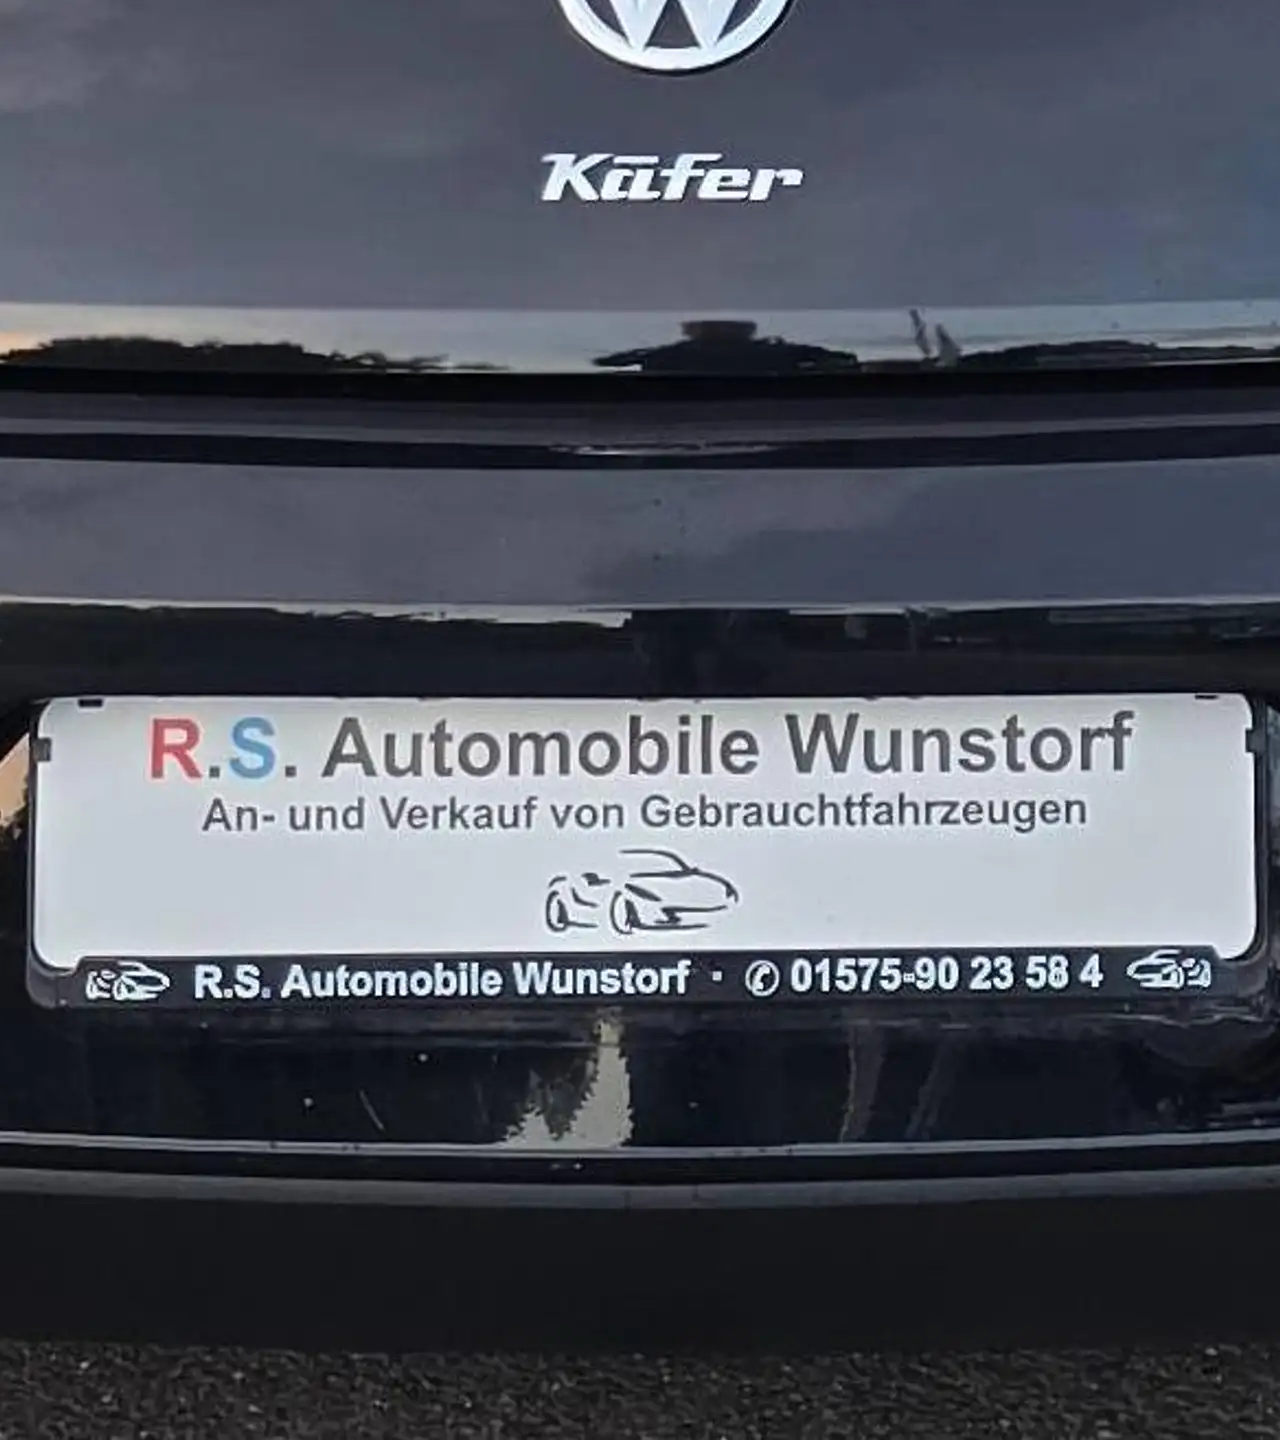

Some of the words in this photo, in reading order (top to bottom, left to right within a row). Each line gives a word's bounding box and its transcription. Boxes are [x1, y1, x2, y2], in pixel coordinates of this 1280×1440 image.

[149, 715, 297, 780] R.S.
[320, 714, 759, 778] Automobile
[785, 710, 1135, 774] Wunstorf
[201, 797, 276, 832] An-
[288, 796, 365, 830] und
[379, 795, 539, 830] Verkauf
[549, 803, 625, 828] von
[639, 792, 1088, 833] Gebrauchtfahrzeugen
[193, 963, 272, 999] R.S.
[280, 962, 502, 998] Automobile
[512, 958, 691, 996] Wunstorf
[790, 956, 959, 992] 01575-90
[969, 955, 1015, 991] 23
[1025, 954, 1069, 989] 58
[1077, 953, 1104, 987] 4
